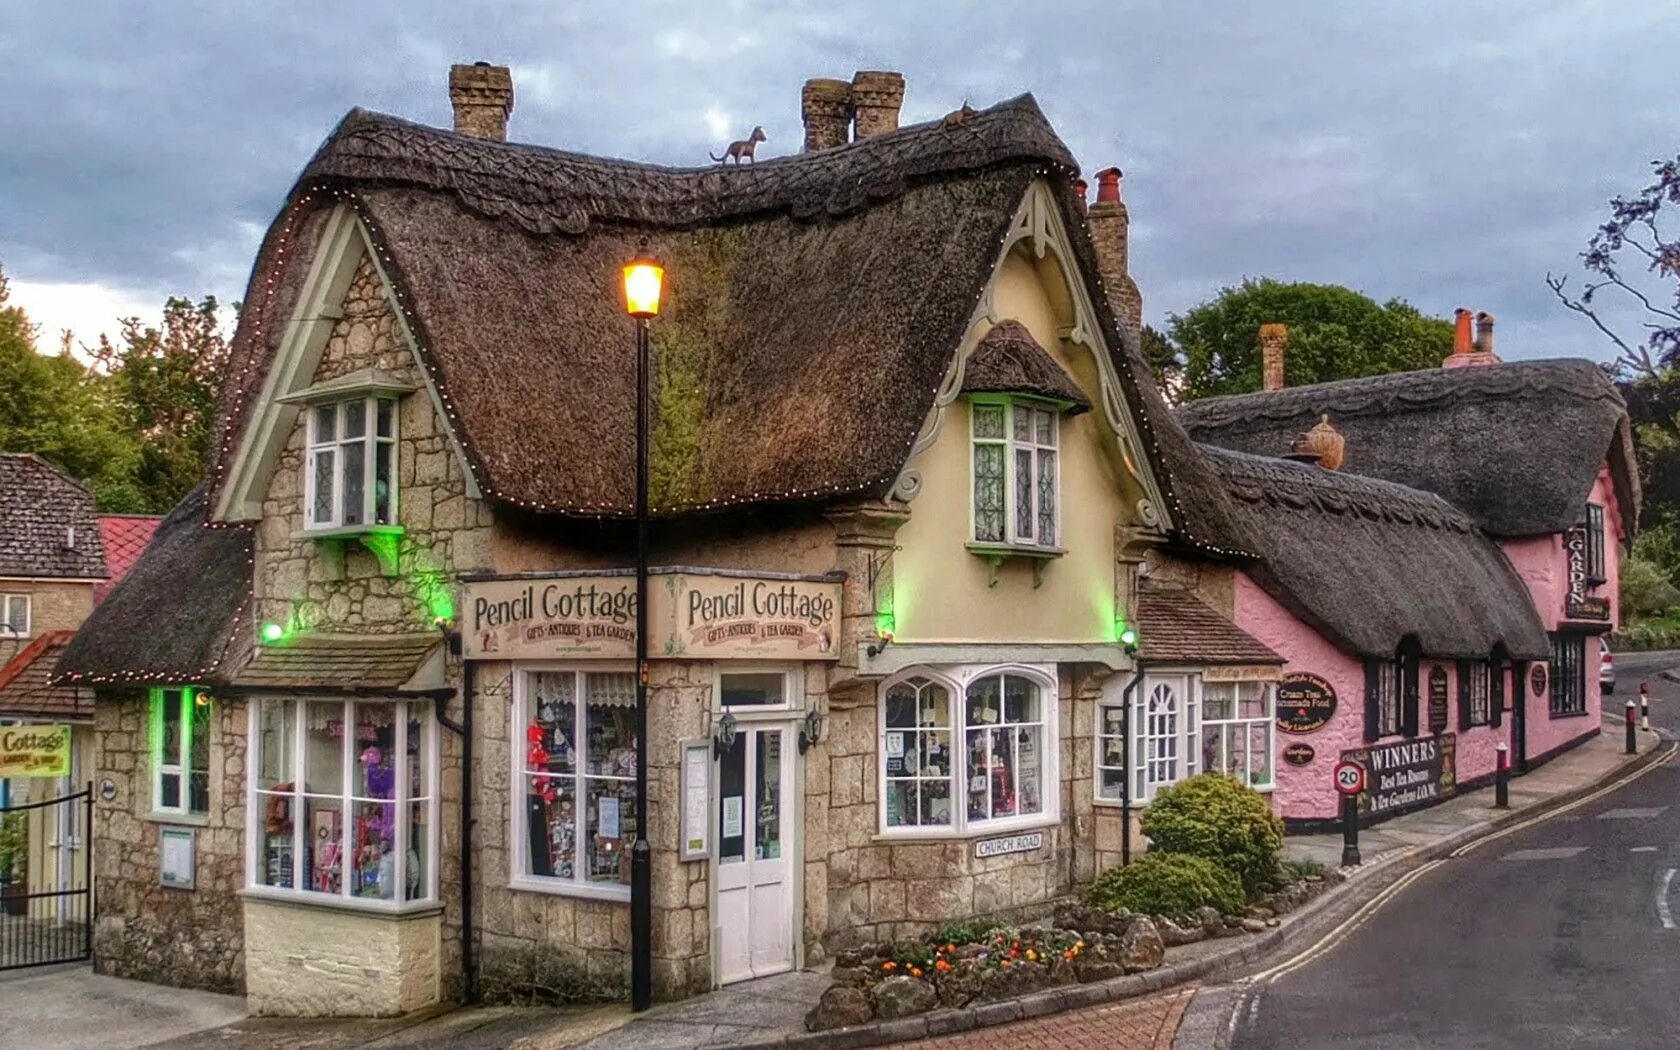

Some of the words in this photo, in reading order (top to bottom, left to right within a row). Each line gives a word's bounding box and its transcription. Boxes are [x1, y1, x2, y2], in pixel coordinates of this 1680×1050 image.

[1568, 540, 1584, 604] GARDEN
[475, 586, 533, 630] Pencil
[542, 584, 637, 624] Cottage
[689, 582, 745, 626] Pencil
[753, 582, 833, 627] Cottage
[527, 626, 544, 640] GIFTS
[547, 624, 581, 637] ANTIQUES
[592, 624, 606, 637] TEA
[607, 625, 636, 641] GARDEN
[708, 629, 726, 643] GIFTS
[727, 623, 756, 637] ANTIQUES
[767, 625, 779, 637] TEA
[779, 624, 804, 637] GARDEN
[1311, 699, 1330, 708] Food
[3, 731, 64, 752] Cottage
[1370, 740, 1436, 771] WINNERS
[1340, 771, 1358, 785] 20
[1380, 775, 1395, 790] Best
[1396, 771, 1407, 787] Tea
[1408, 769, 1429, 783] Rooms
[1378, 794, 1389, 810] Tea
[1390, 788, 1416, 807] Gardens
[980, 838, 1013, 855] CHURCH
[1016, 835, 1040, 849] ROAD
